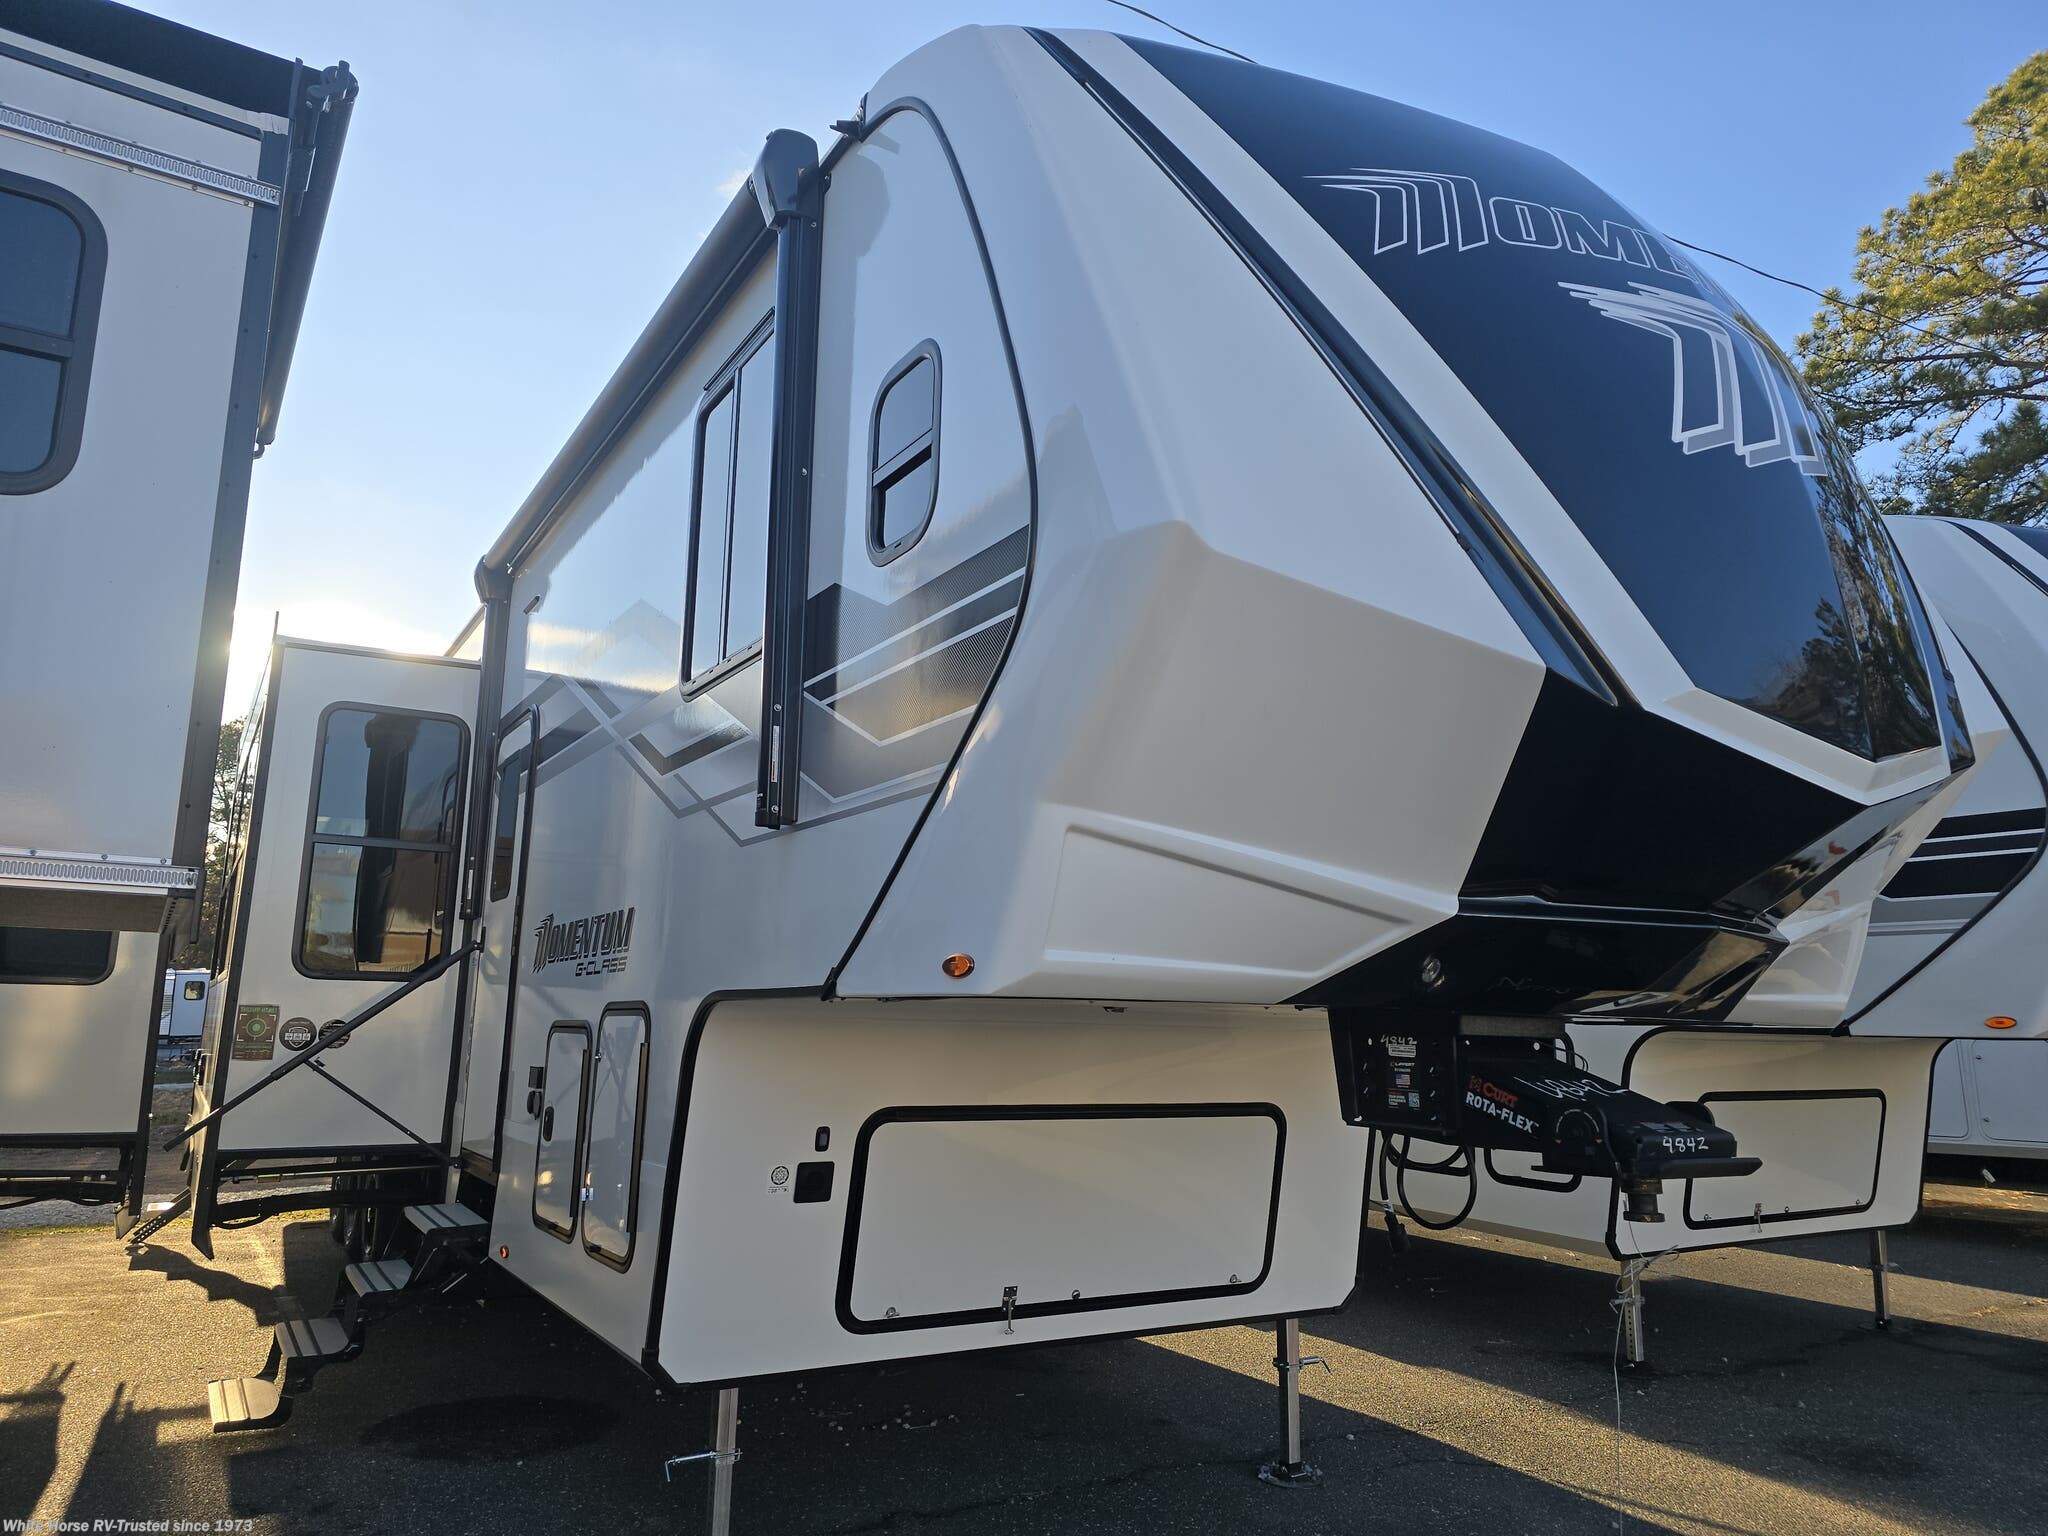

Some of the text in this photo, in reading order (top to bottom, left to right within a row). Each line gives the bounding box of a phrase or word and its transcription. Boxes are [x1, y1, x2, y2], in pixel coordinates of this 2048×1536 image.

[532, 906, 635, 974] MOMENTUM
[575, 956, 628, 977] G-CLASS
[1662, 1136, 1709, 1154] 4842
